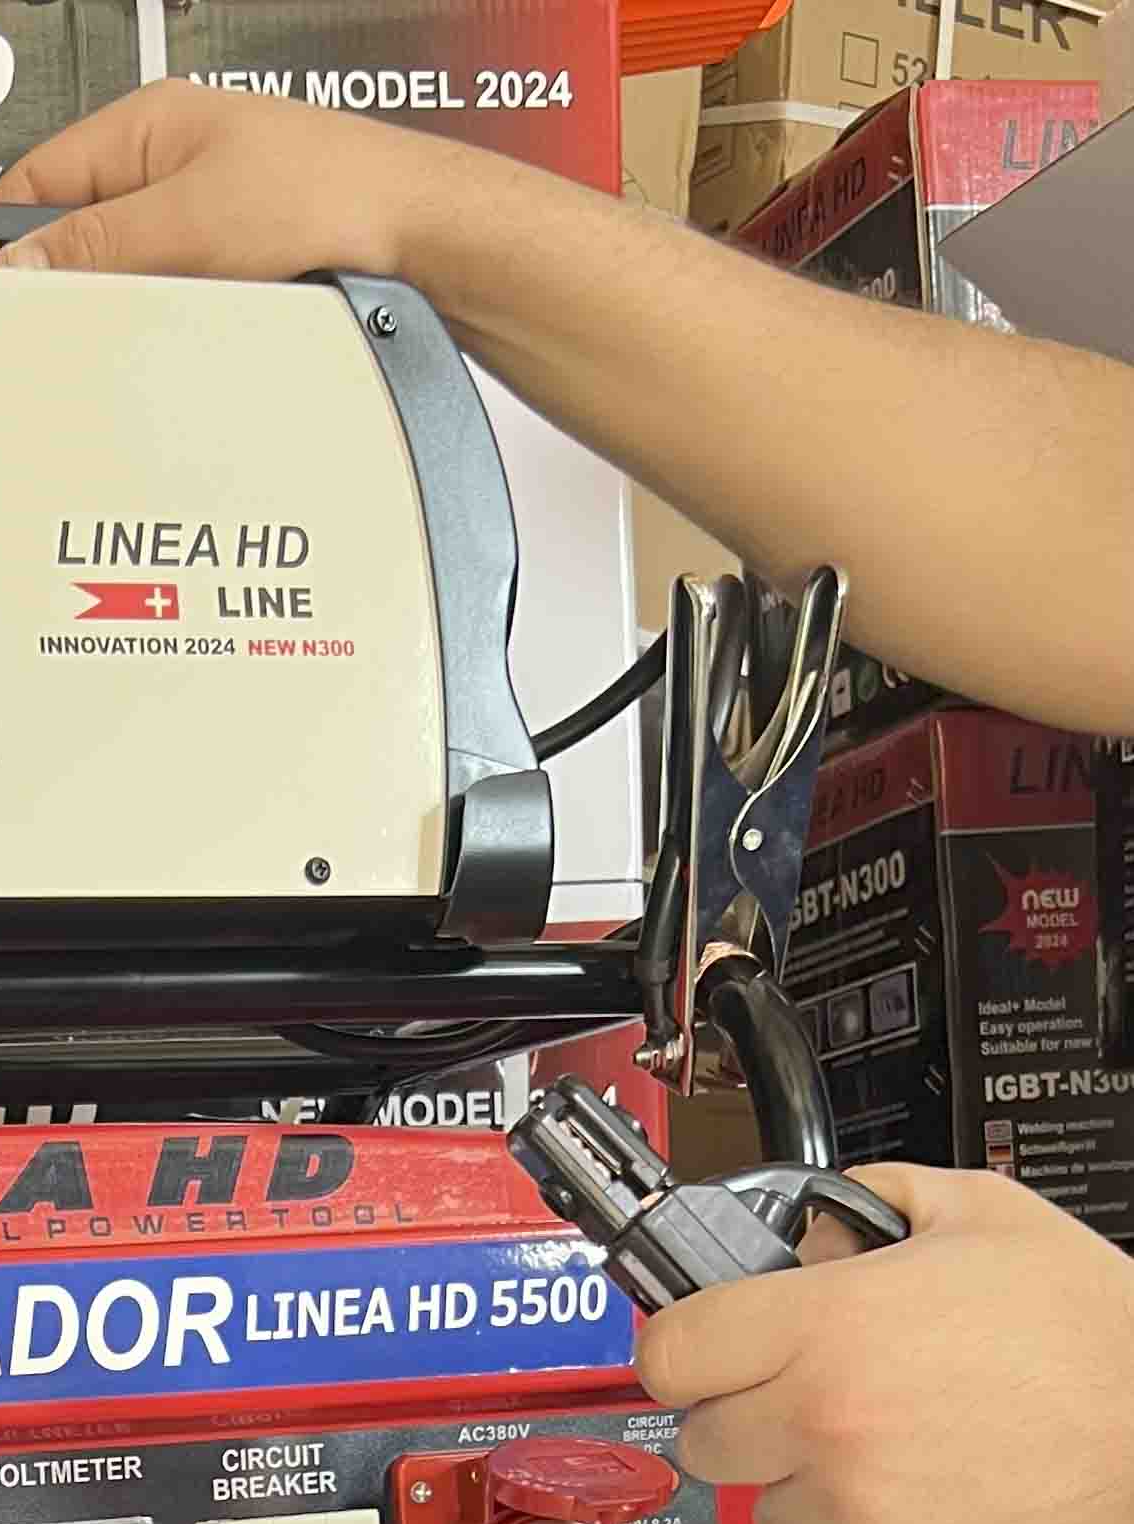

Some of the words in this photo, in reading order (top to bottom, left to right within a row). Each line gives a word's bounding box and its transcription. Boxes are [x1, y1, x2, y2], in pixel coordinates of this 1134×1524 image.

[306, 71, 464, 108] MODEL
[476, 70, 573, 108] 2024
[58, 521, 220, 568] LINEA
[237, 524, 310, 570] HD
[217, 586, 313, 619] LINE
[39, 636, 178, 656] INNOVATION
[185, 636, 236, 656] 2024
[247, 637, 296, 657] NEW
[302, 638, 356, 657] N300
[1026, 912, 1079, 929] MODEL
[979, 1020, 1015, 1038] Easy
[1017, 1015, 1084, 1037] operation
[980, 1038, 1038, 1056] Suitable
[146, 1133, 357, 1208] HD
[245, 1286, 395, 1343] LINEA
[408, 1283, 478, 1334] HD
[489, 1273, 609, 1325] 5500
[457, 1422, 532, 1443] AC380V
[627, 1414, 675, 1429] CIRCUIT
[221, 1442, 324, 1474] CIRCUIT
[212, 1471, 337, 1501] BREAKER
